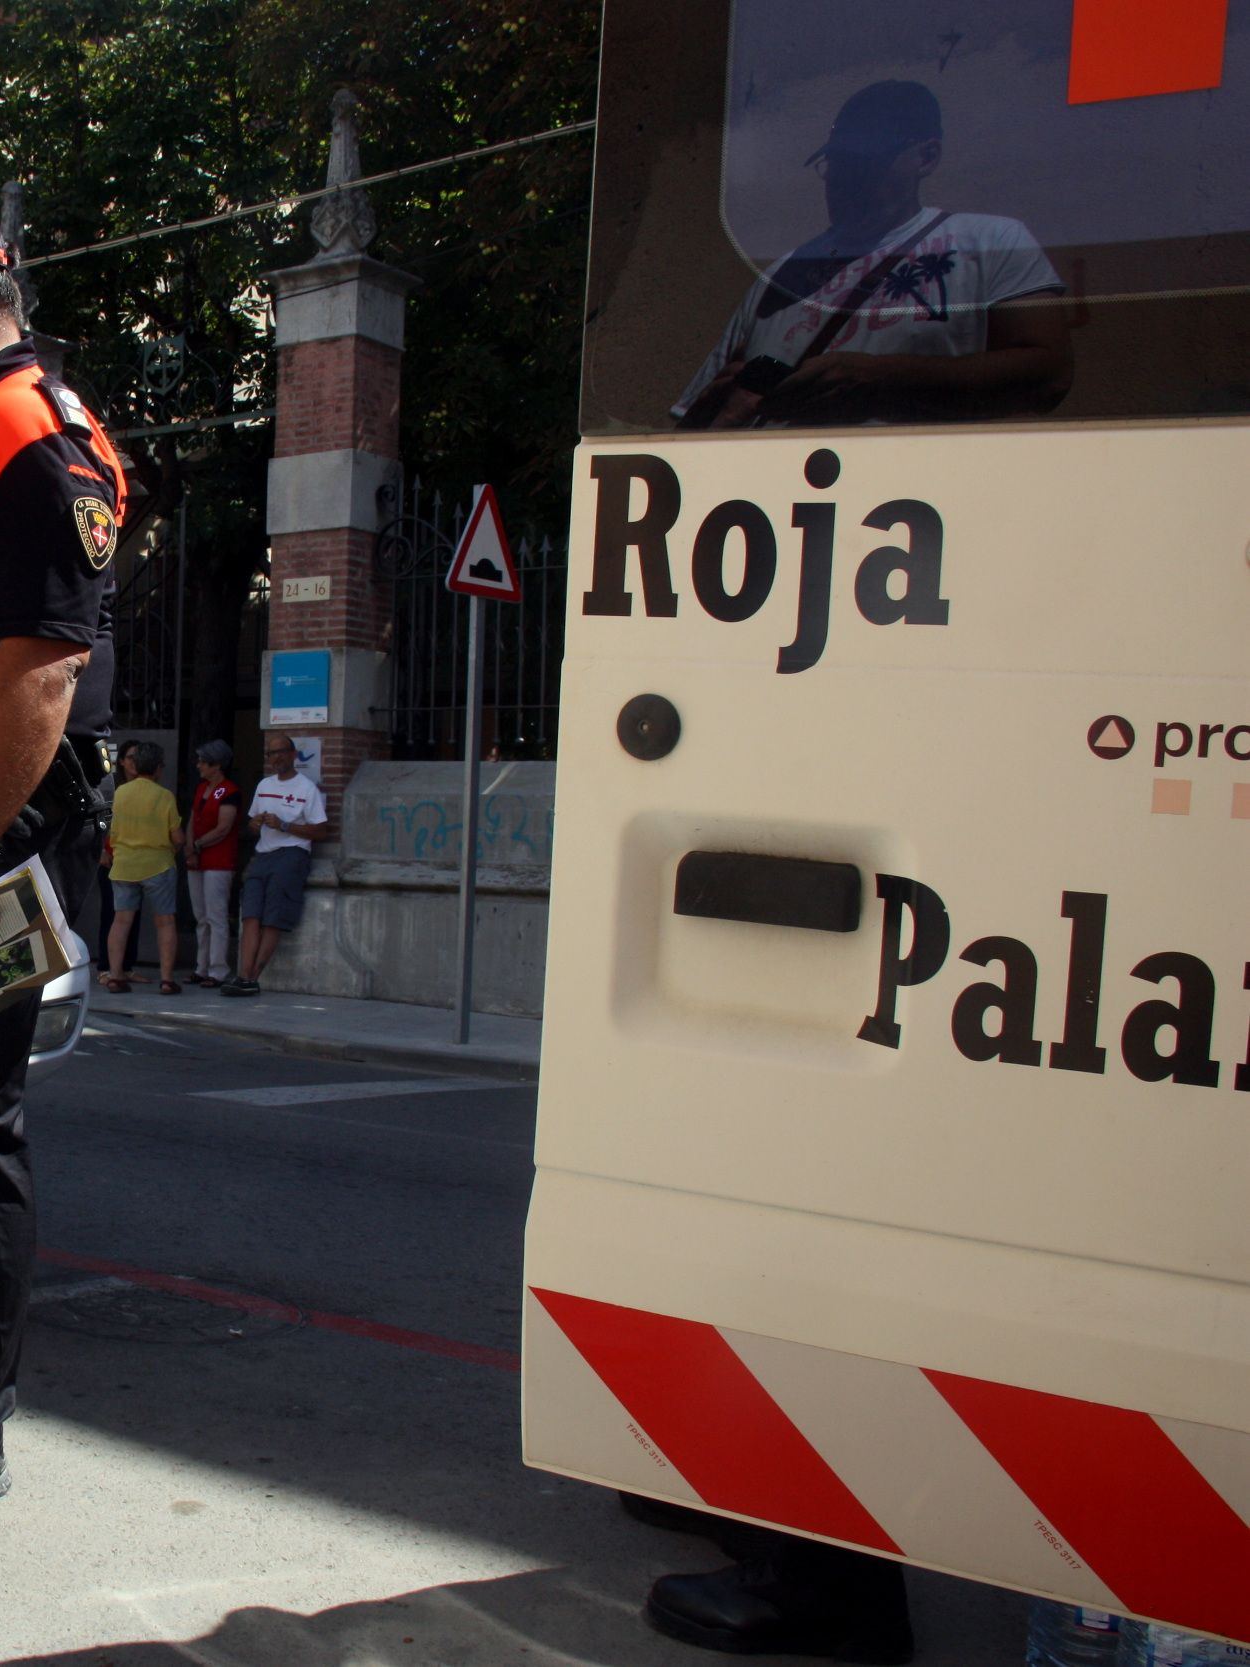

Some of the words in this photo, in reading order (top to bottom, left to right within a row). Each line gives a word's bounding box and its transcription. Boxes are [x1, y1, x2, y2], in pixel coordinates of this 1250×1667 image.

[582, 448, 950, 674] Roja
[626, 1422, 650, 1450] TPESC
[1034, 1519, 1062, 1550] TPESC
[1060, 1550, 1082, 1570] 3117
